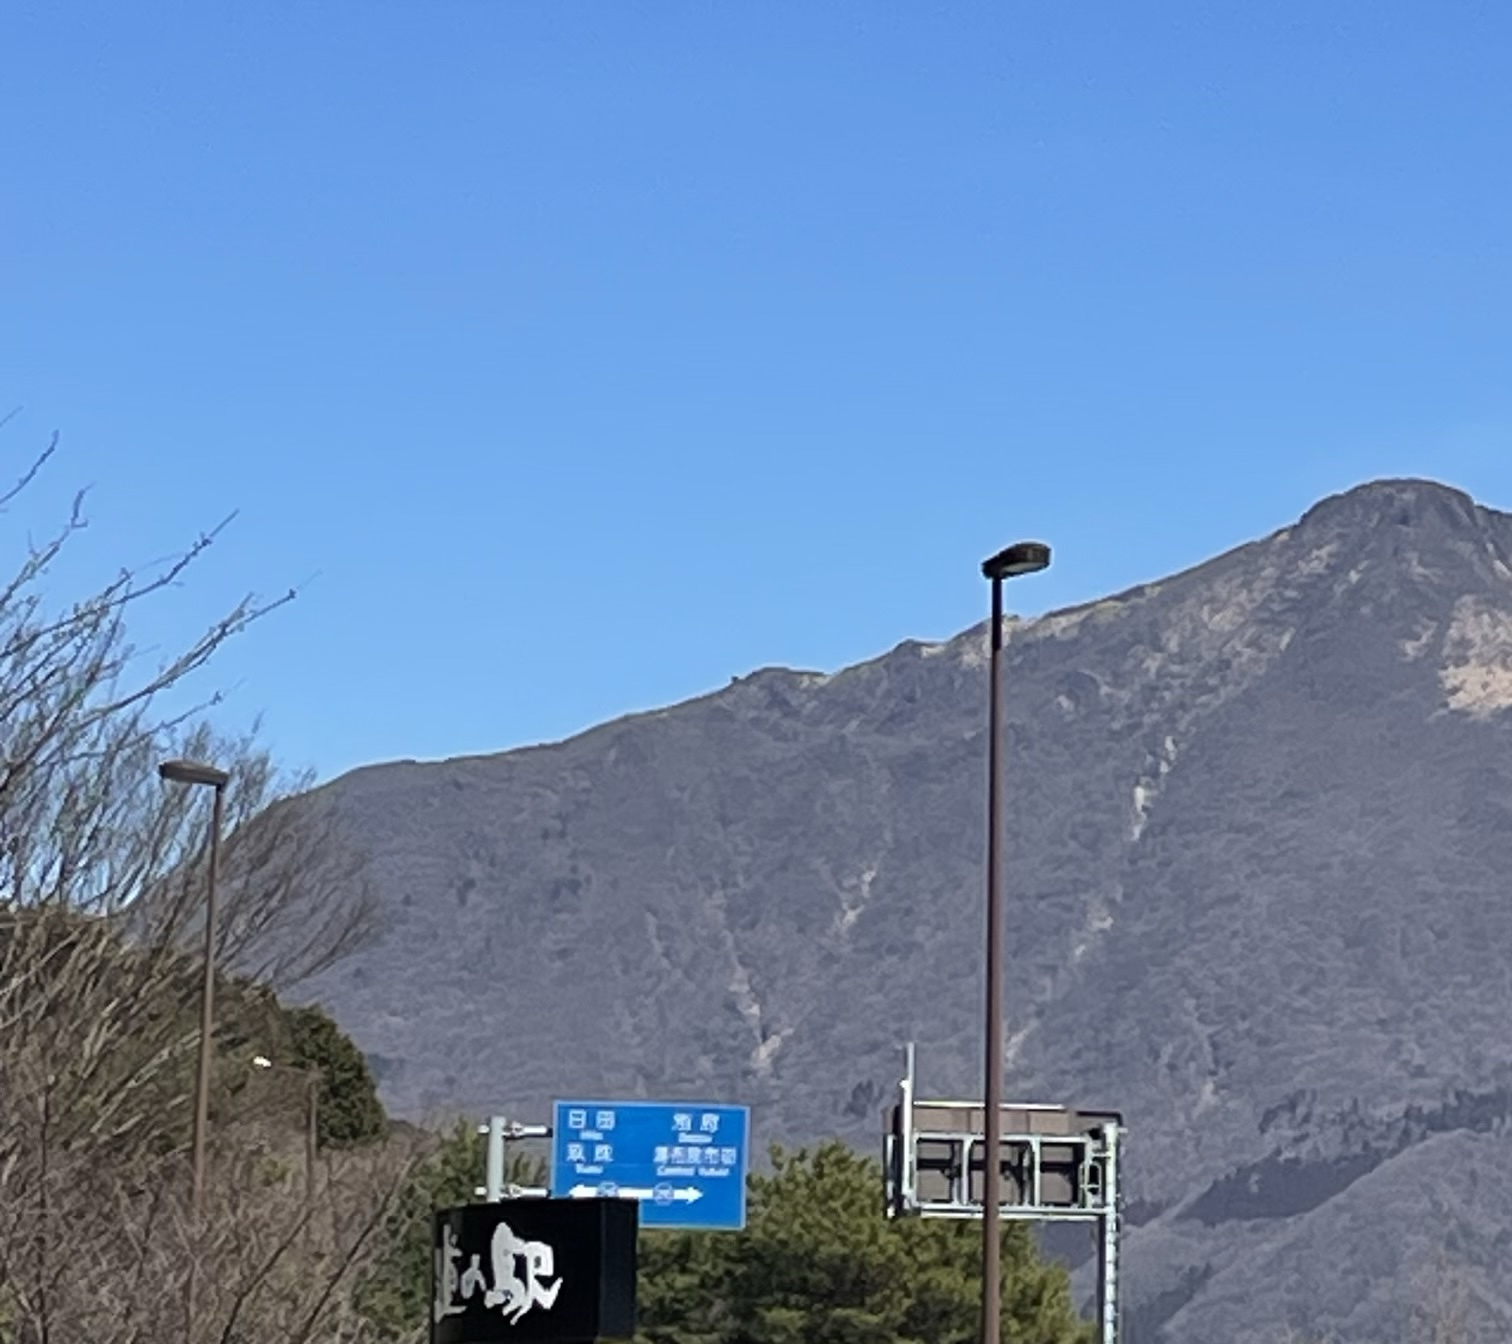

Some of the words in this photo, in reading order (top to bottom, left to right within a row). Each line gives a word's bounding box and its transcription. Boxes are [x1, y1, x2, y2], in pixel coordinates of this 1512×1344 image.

[568, 1109, 616, 1131] 日田
[434, 1222, 564, 1326] 道の駅
